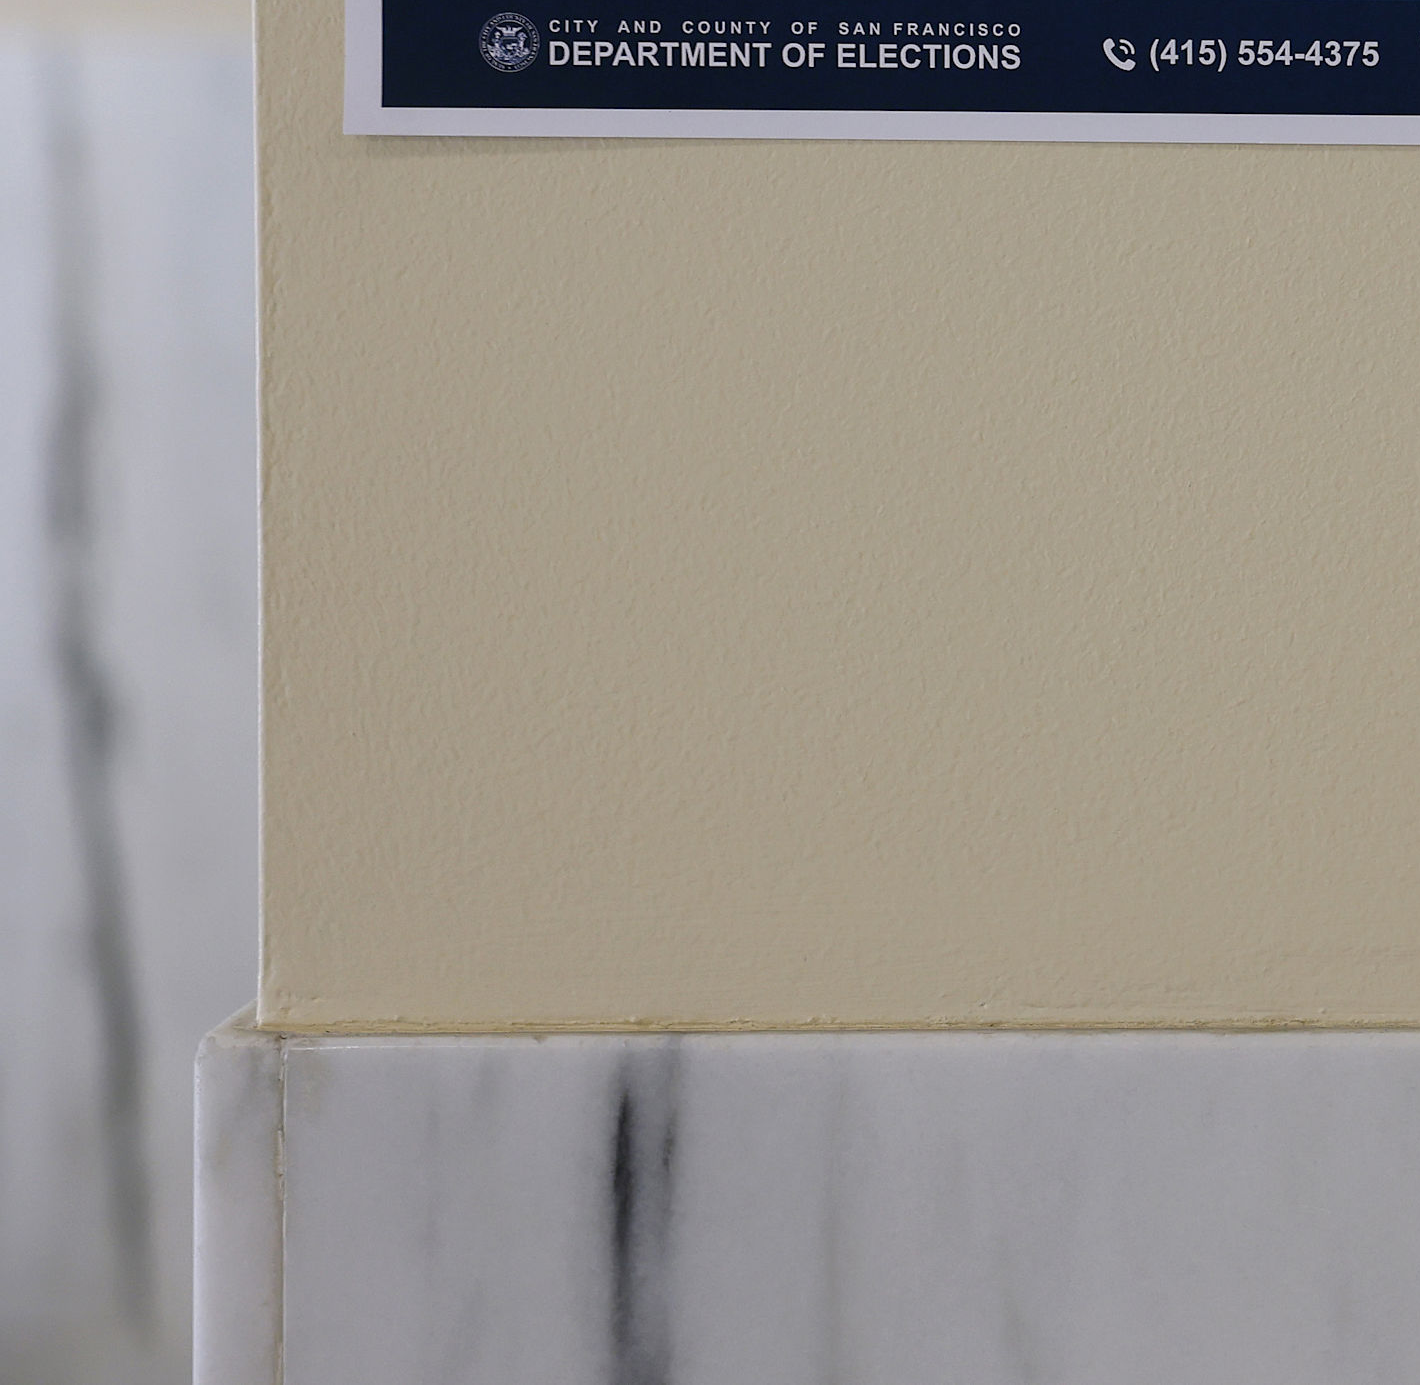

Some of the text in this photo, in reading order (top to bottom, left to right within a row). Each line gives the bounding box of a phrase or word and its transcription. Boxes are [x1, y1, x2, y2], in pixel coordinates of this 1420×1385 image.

[548, 19, 1021, 37] CITY AND COUNTY OF SAN FRANCISCO
[549, 40, 772, 68] DEPARTMENT
[781, 42, 826, 68] OF
[837, 43, 1021, 70] ELECTIONS
[1149, 38, 1380, 73] (415) 554-4375
